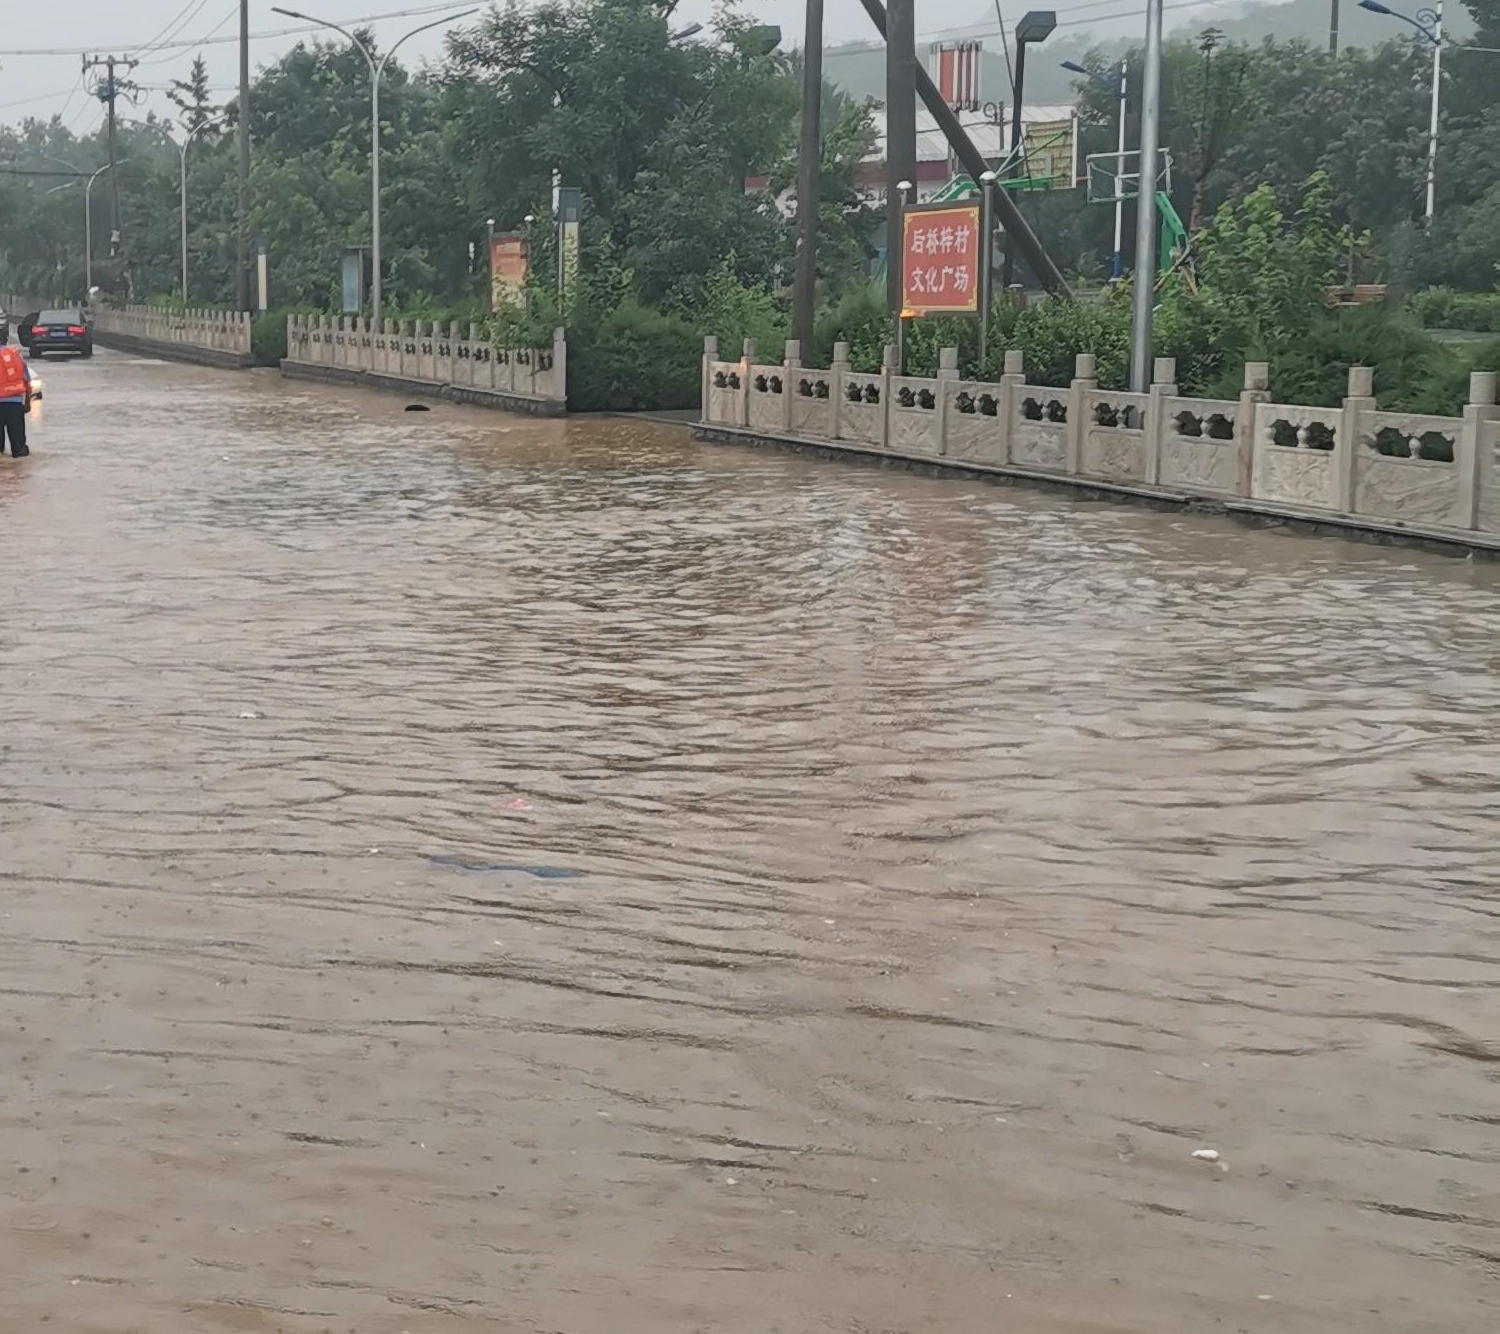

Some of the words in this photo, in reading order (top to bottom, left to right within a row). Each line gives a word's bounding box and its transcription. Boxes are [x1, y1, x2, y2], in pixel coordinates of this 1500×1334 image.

[911, 225, 970, 254] 后桥梓村
[910, 266, 969, 293] 文化广场
